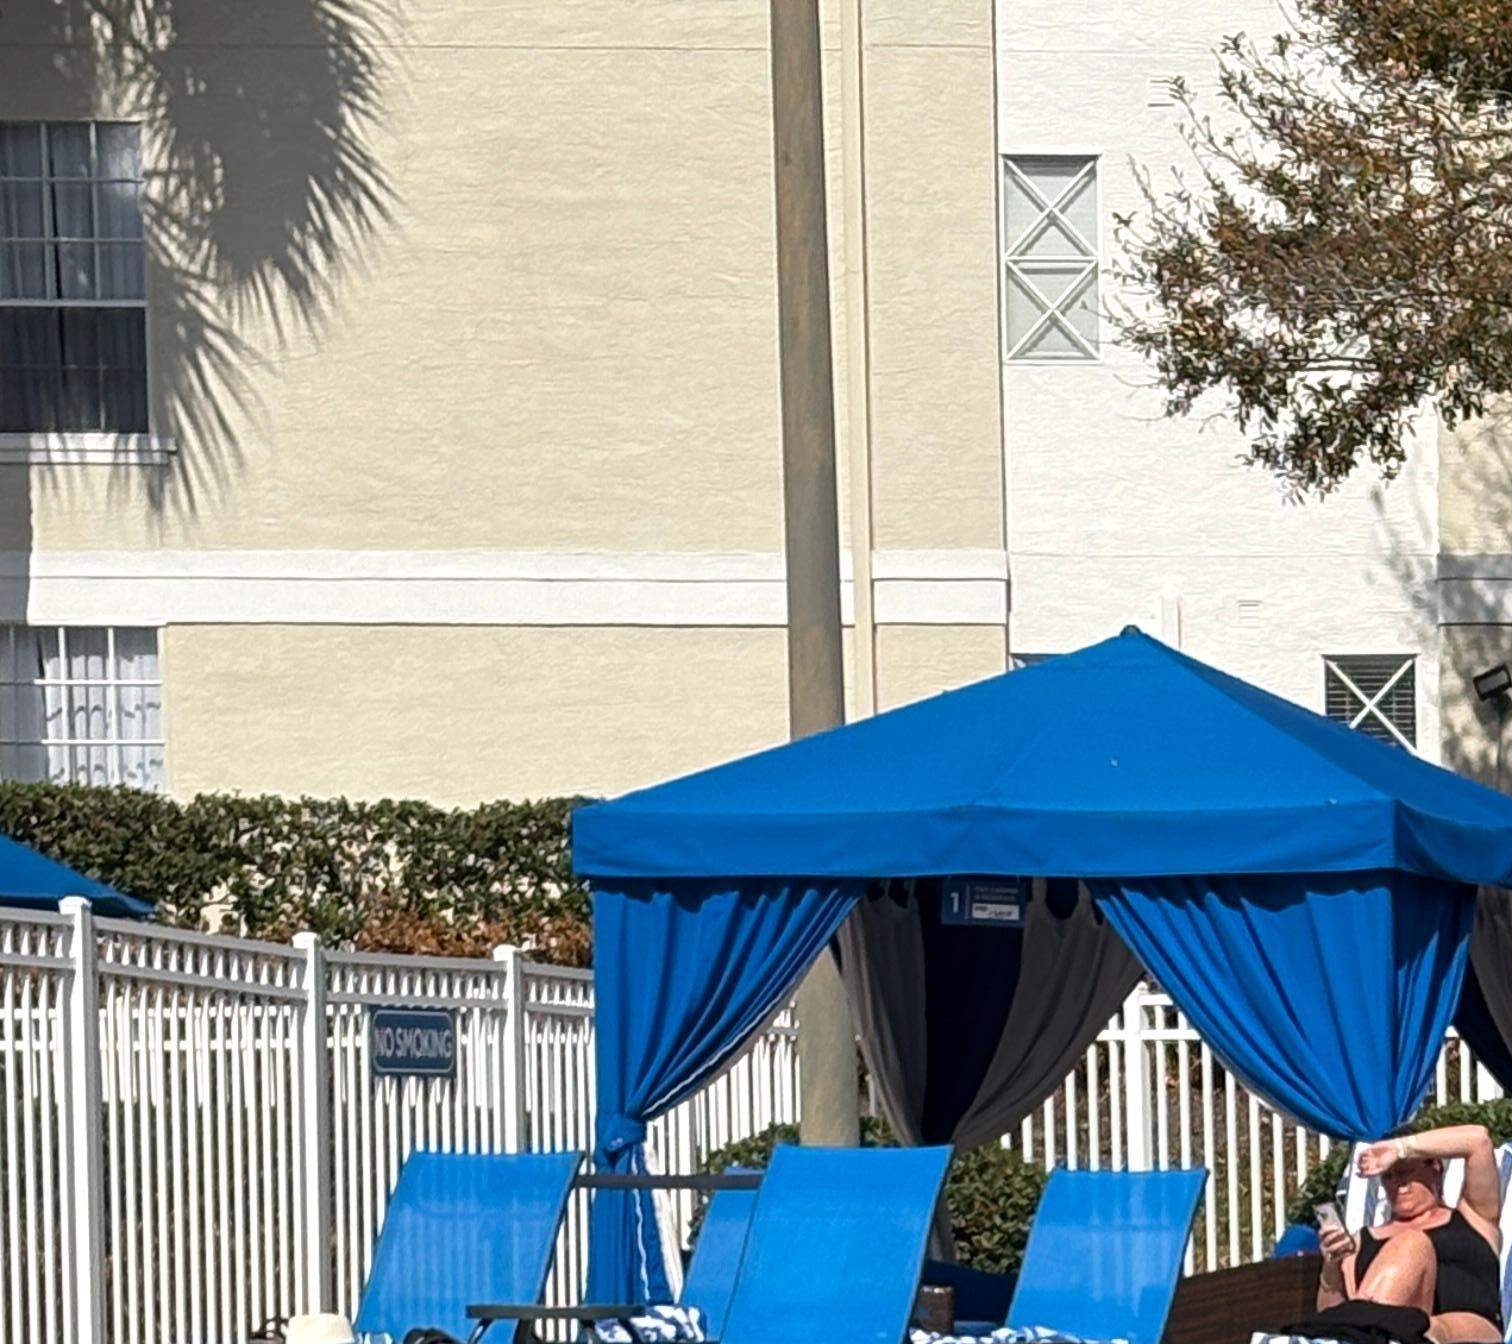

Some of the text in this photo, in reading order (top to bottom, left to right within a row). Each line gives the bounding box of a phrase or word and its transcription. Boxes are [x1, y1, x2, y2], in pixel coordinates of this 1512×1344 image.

[949, 892, 960, 914] 1
[374, 1027, 452, 1058] NO SMOKING
